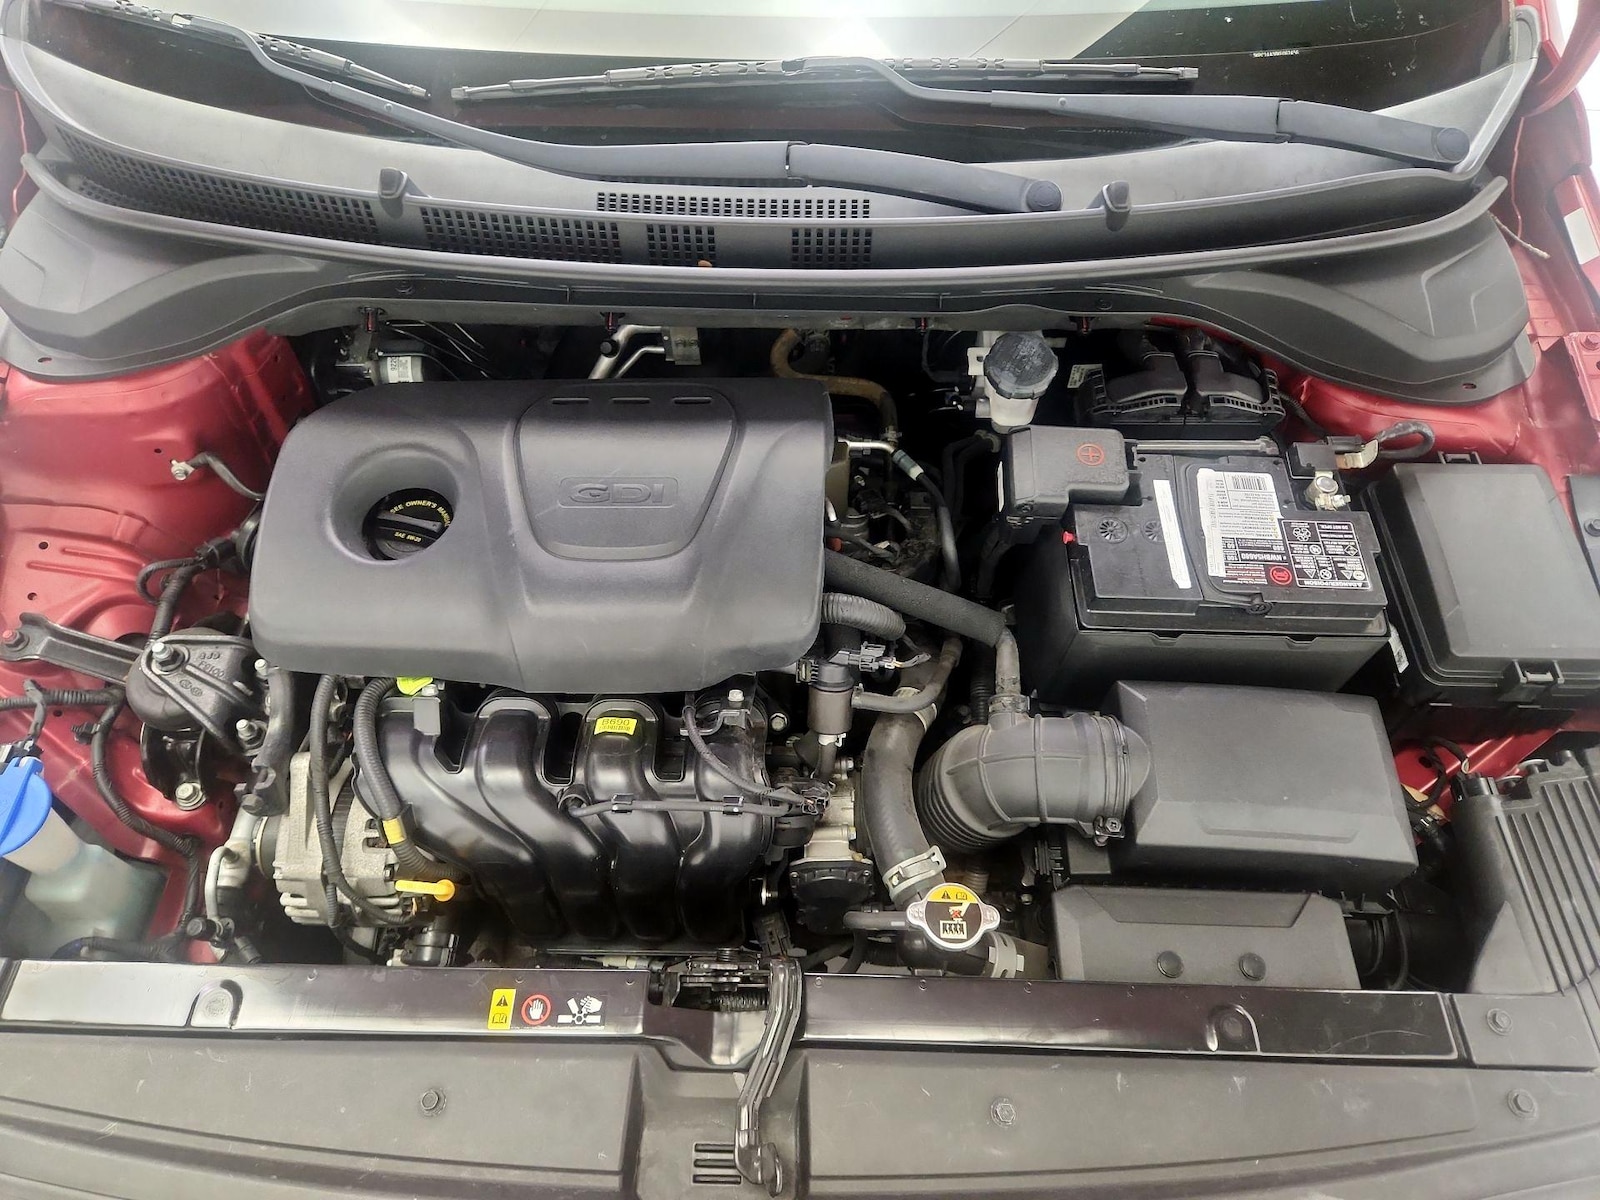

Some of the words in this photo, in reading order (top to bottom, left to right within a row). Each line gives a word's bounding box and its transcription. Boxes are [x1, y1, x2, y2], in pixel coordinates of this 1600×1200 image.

[569, 482, 665, 504] GDI
[390, 504, 404, 514] SEE
[405, 499, 438, 509] OWNER'S
[437, 507, 451, 527] MANUA
[601, 718, 630, 726] B690
